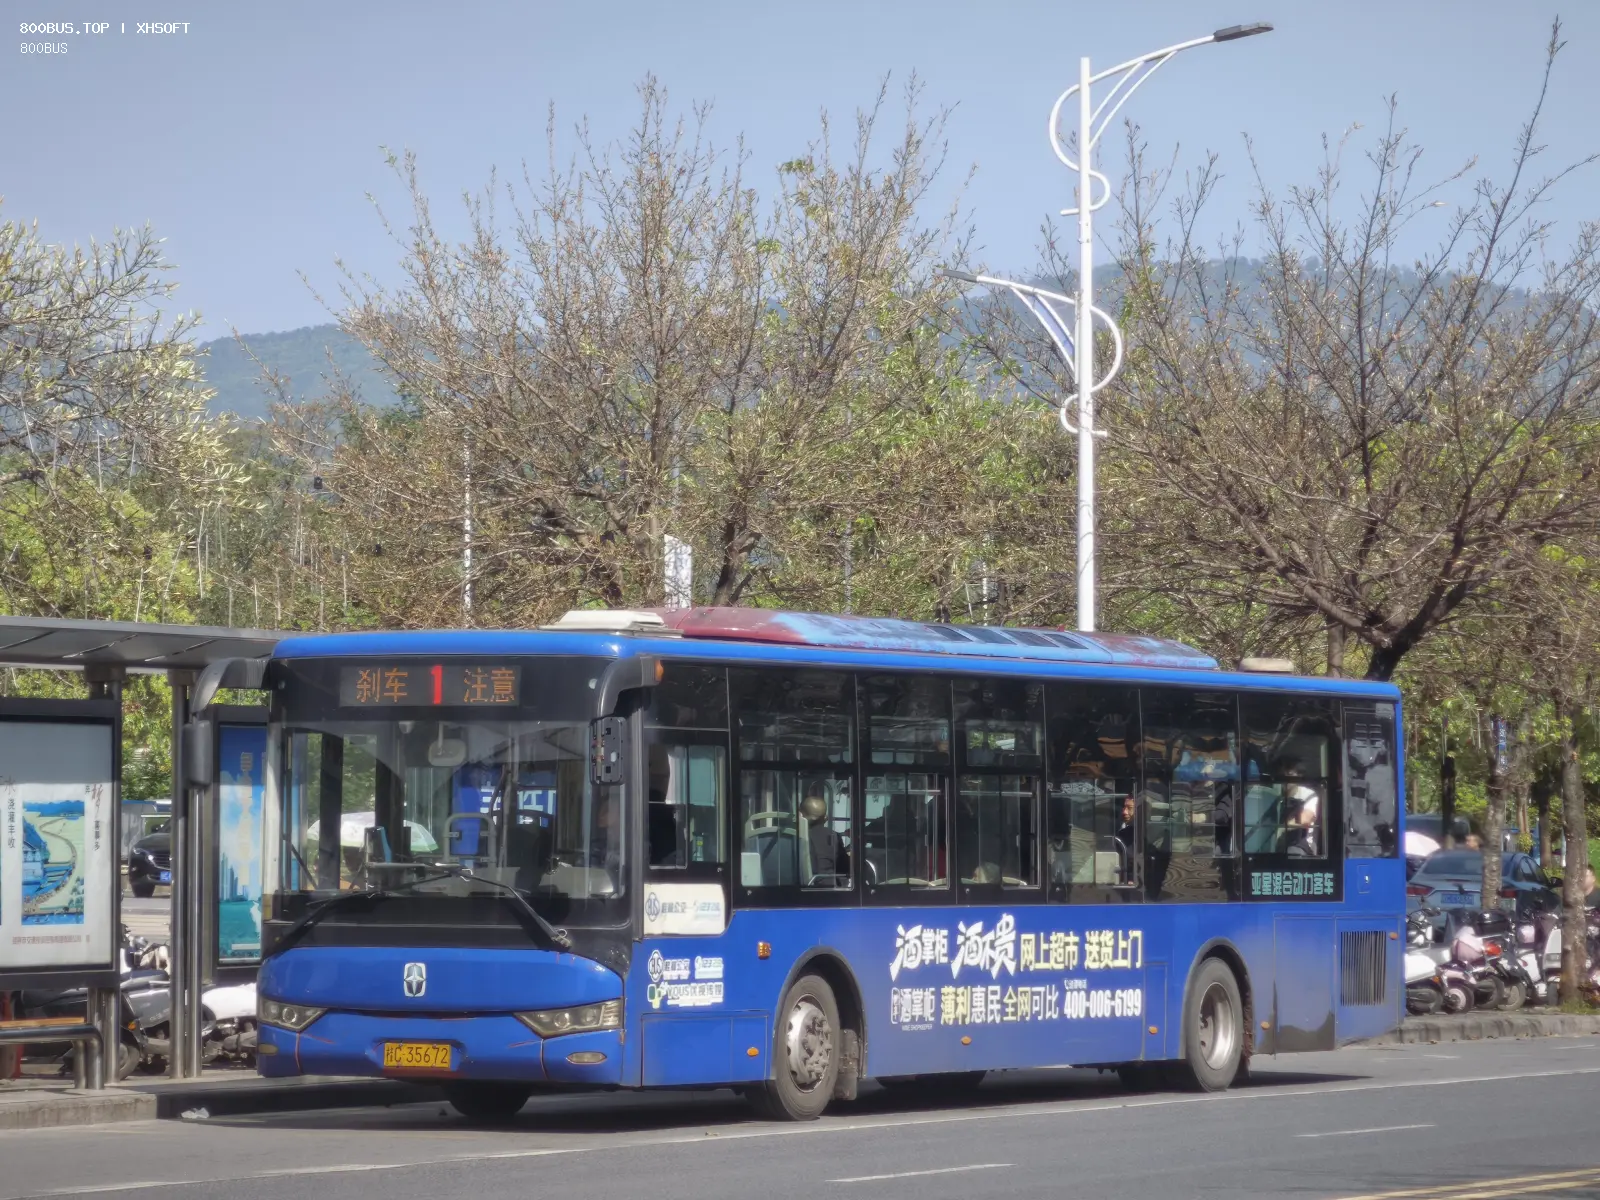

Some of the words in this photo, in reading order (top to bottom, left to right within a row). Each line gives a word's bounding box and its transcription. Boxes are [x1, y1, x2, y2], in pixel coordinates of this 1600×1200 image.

[356, 667, 408, 702] 刹车
[430, 664, 443, 705] 1
[463, 666, 515, 702] 注意
[1251, 871, 1334, 896] 亚星混合动力客车
[889, 924, 949, 982] 酒掌柜
[1020, 931, 1080, 972] 网上超市
[1084, 930, 1142, 970] 送货上门
[900, 987, 936, 1023] 酒掌柜
[1064, 989, 1142, 1019] 400-006-6199
